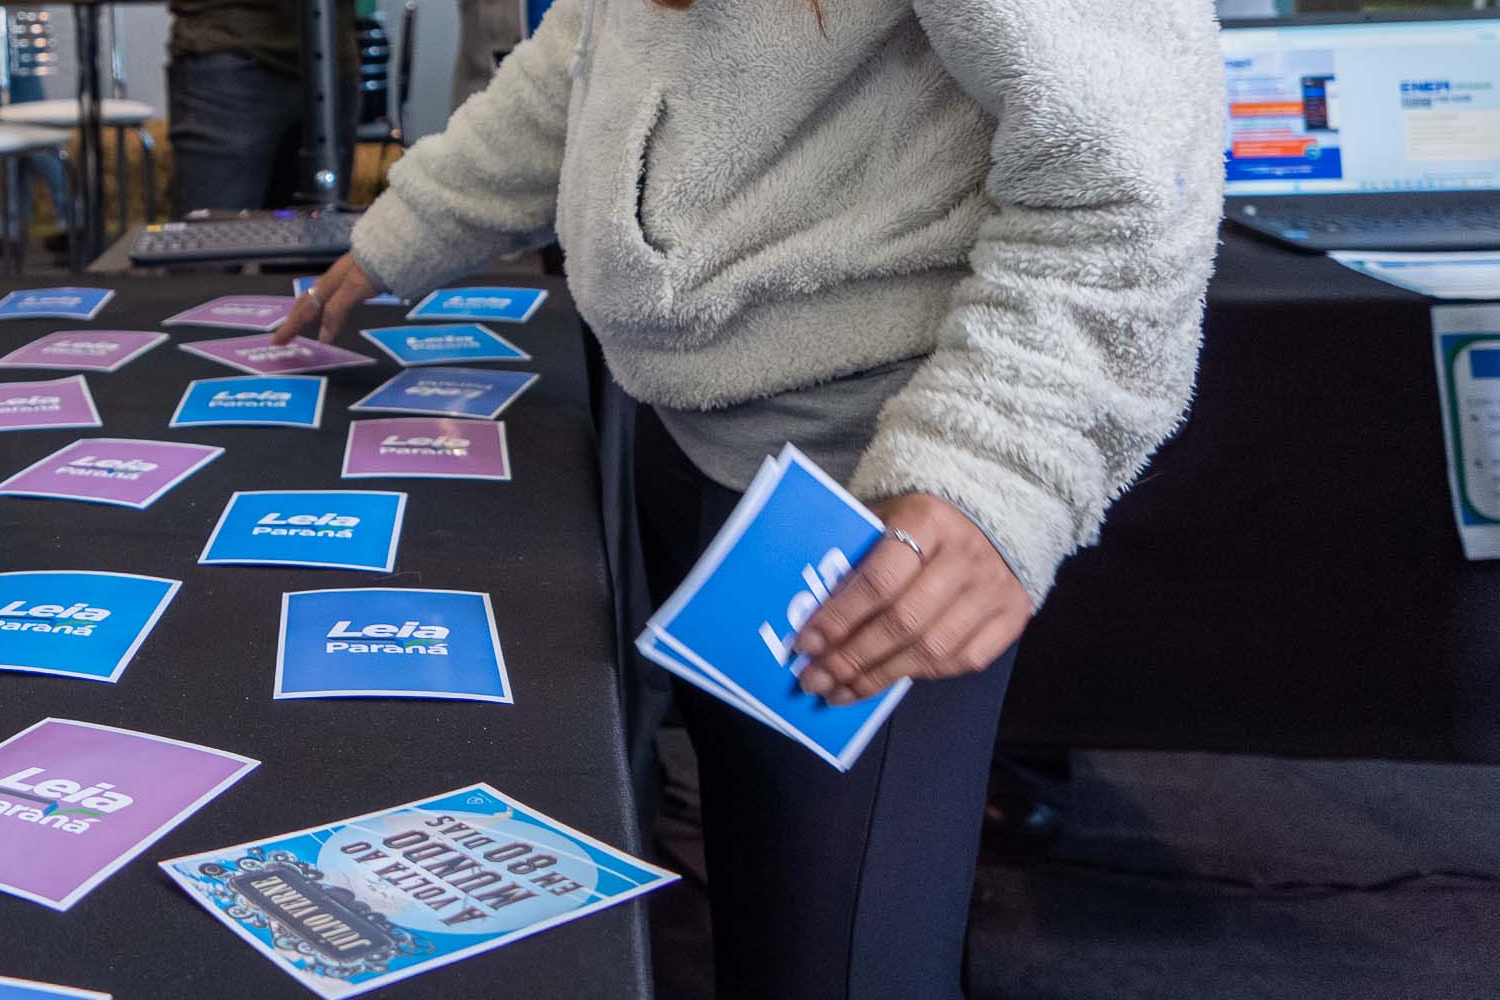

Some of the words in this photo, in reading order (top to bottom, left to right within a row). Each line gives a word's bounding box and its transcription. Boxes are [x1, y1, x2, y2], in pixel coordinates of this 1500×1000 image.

[212, 389, 292, 401] Leia
[380, 435, 470, 447] Leia
[67, 455, 159, 472] Leia
[257, 512, 361, 527] Leia
[251, 526, 354, 539] Paraná
[326, 620, 450, 639] Leia
[326, 641, 449, 655] Paraná
[425, 815, 498, 850] DIAS
[339, 841, 390, 864] AO
[482, 841, 558, 876] 80
[382, 829, 541, 911] MUNDO
[372, 861, 460, 912] VOLTA
[529, 870, 585, 897] EM
[251, 875, 319, 919] VERNE
[438, 905, 493, 927] A
